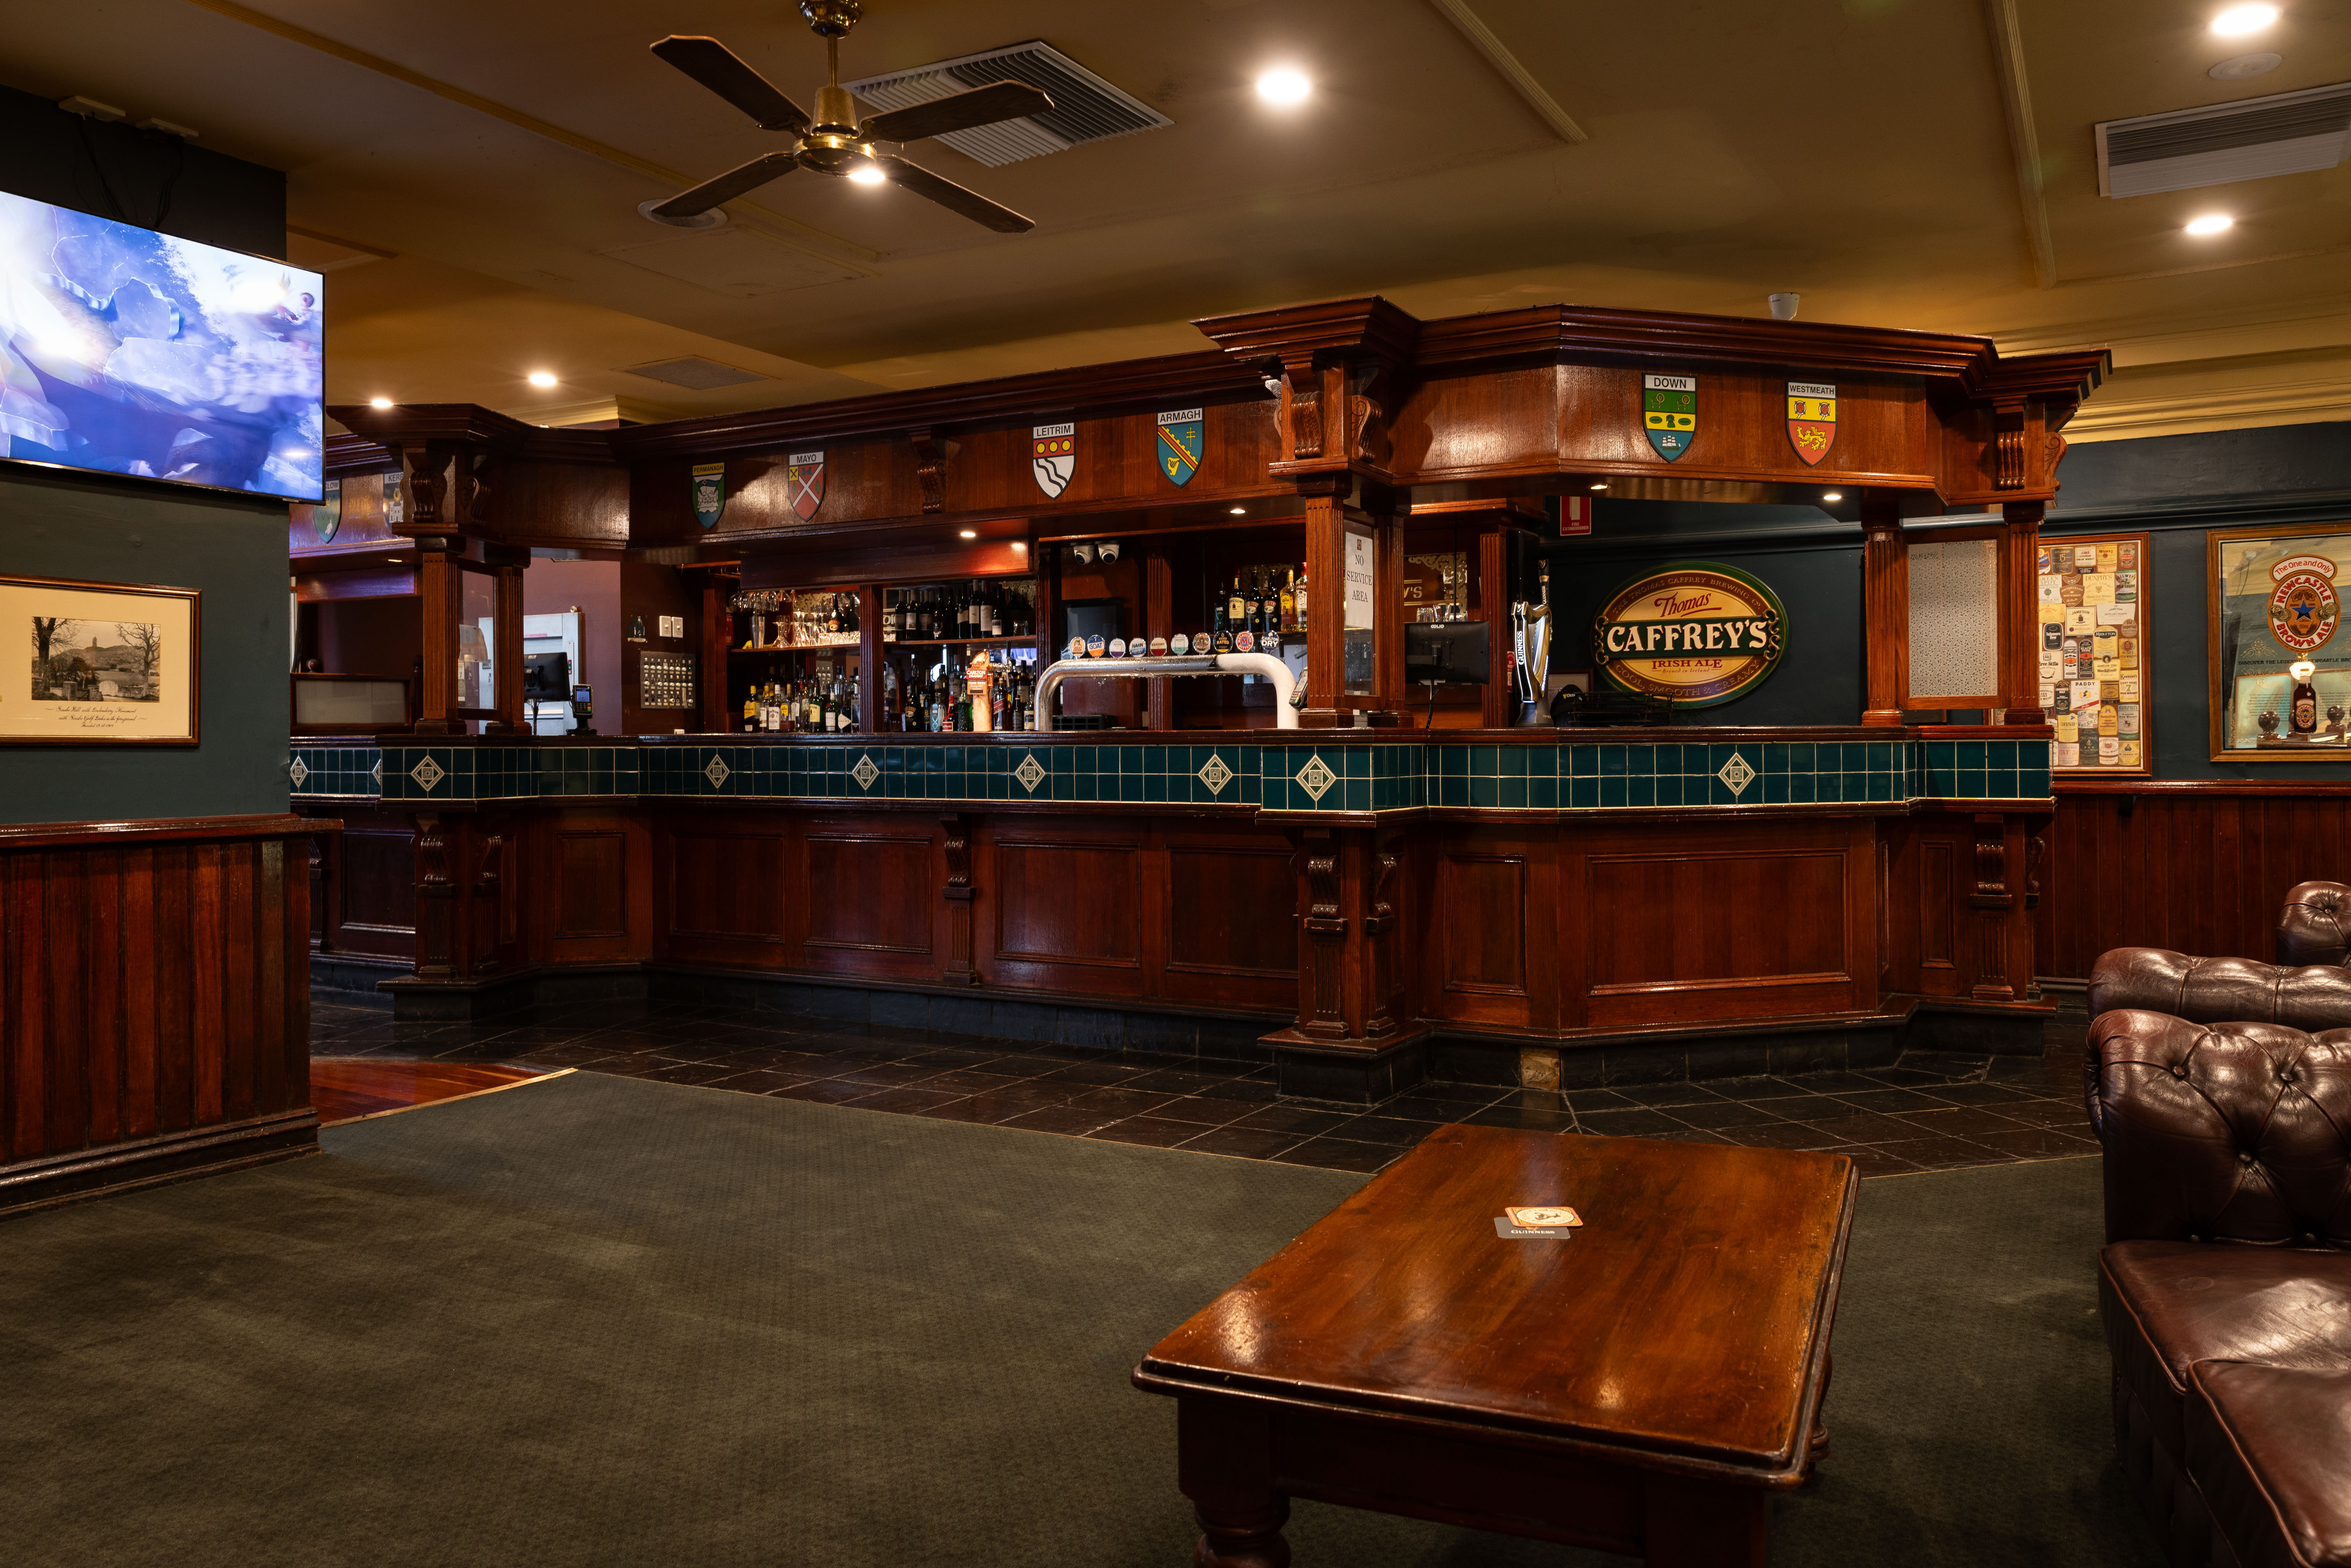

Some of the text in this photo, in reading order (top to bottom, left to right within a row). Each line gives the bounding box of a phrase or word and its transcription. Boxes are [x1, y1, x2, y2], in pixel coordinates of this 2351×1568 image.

[1654, 378, 1686, 389] DOWN
[1789, 385, 1835, 395] WESTMEATH
[1159, 409, 1201, 423] ARMAGH
[1036, 425, 1071, 436] LEITRIM
[797, 454, 817, 464] MAYO
[694, 464, 724, 473] FERMANAGH
[1355, 554, 1364, 566] NO
[2059, 554, 2066, 562] 15
[2275, 565, 2288, 575] The
[2317, 562, 2332, 574] Only
[1346, 570, 1372, 586] SERVICE
[1628, 581, 1665, 599] THOMAS
[1710, 579, 1750, 599] BREWING
[2276, 577, 2332, 603] NEWCASTLE
[1352, 590, 1368, 603] AREA
[1654, 591, 1712, 617] Thomas
[1238, 634, 1252, 643] MELBOURNE
[1607, 619, 1767, 652] CAFFREY'S
[2276, 621, 2332, 647] BROWN ALE
[1652, 659, 1723, 670] IRISH ALE
[1648, 684, 1701, 696] SMOOTH
[1715, 660, 1759, 691] CREAMY
